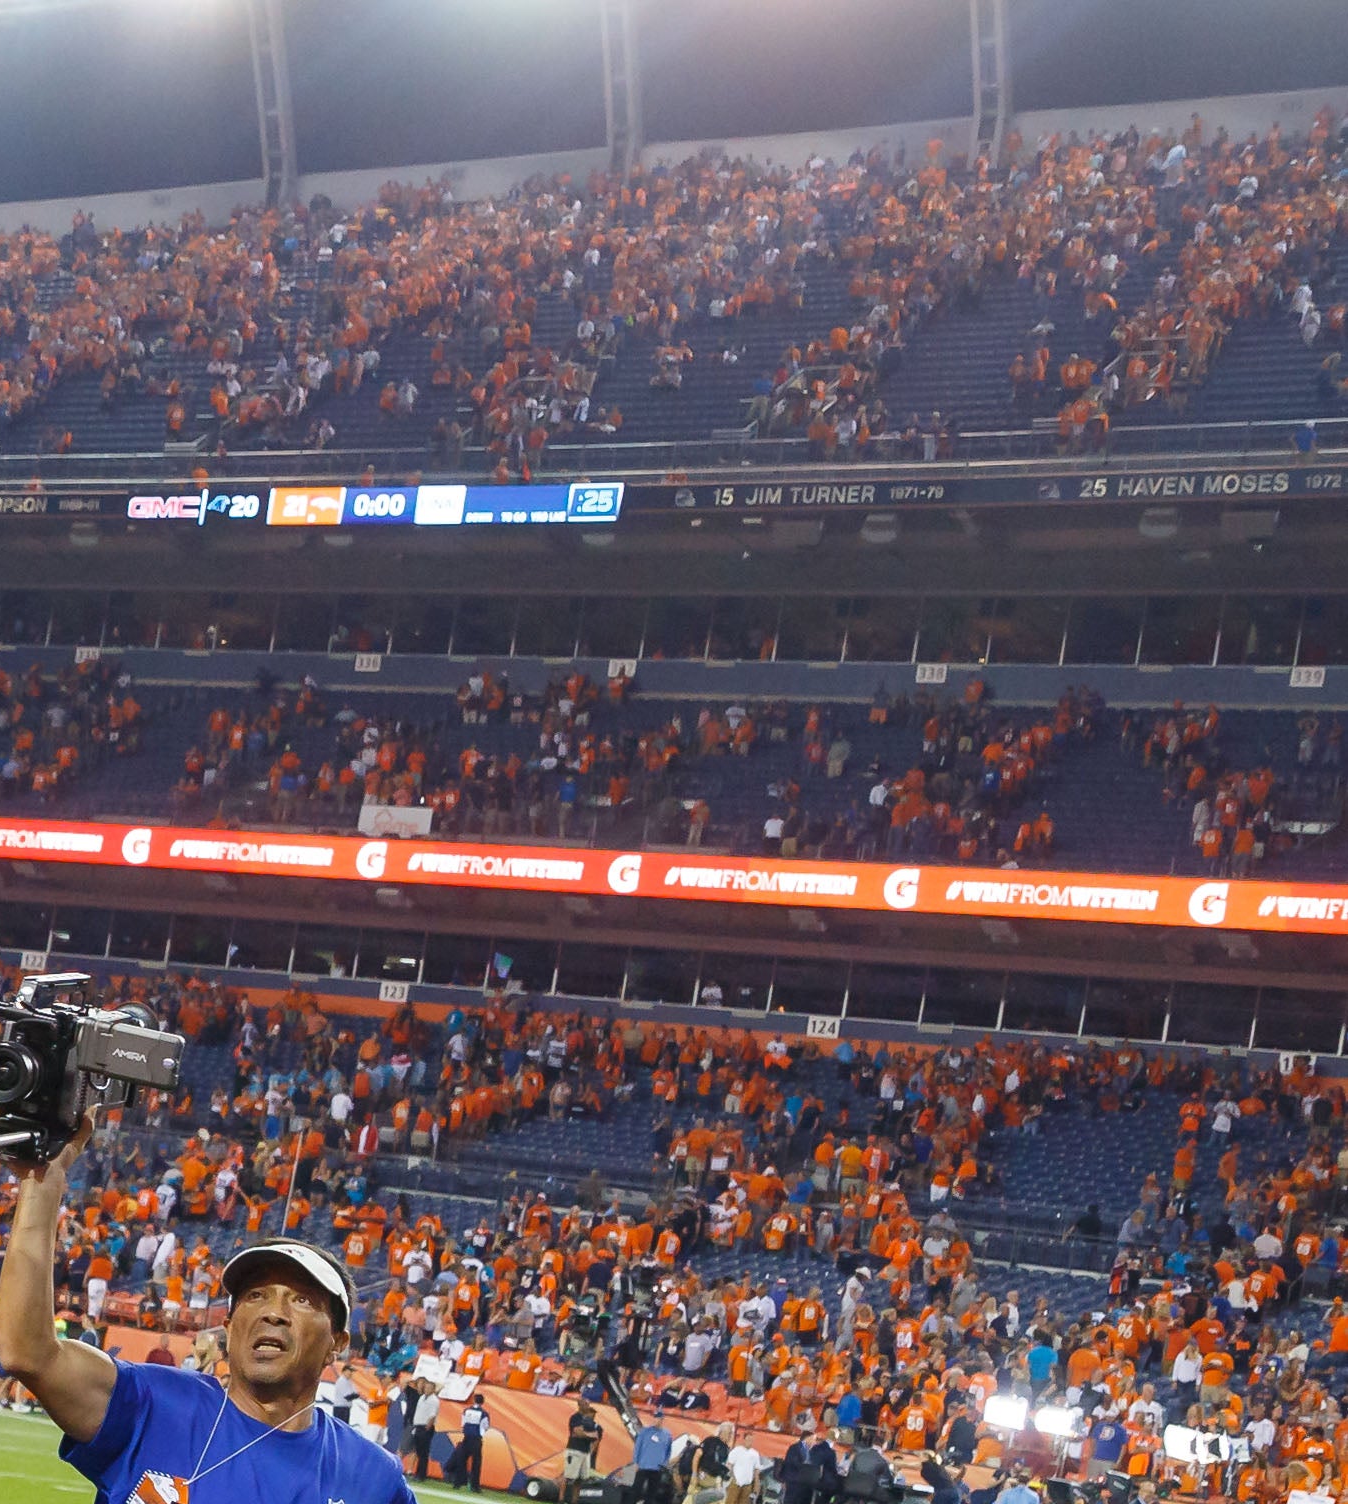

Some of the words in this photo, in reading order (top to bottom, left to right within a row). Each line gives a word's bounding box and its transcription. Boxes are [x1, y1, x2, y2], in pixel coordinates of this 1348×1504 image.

[713, 487, 734, 506] 15
[745, 487, 782, 505] JIM
[790, 485, 876, 505] TURNER
[1079, 477, 1107, 498] 25
[1117, 475, 1195, 498] HAVEN
[1202, 472, 1290, 496] MOSES
[127, 496, 201, 519] GMC
[228, 494, 260, 518] 20
[282, 495, 306, 517] 21
[354, 493, 406, 517] 0:00
[577, 488, 615, 514] :25
[120, 828, 152, 864] G
[355, 841, 388, 878] G
[408, 852, 585, 881] #WINFROMWITHIN
[607, 854, 643, 894] G
[664, 866, 858, 897] #WINFROMWITHIN
[883, 867, 921, 909] G
[946, 880, 1160, 911] #WINFROMWITHIN
[1188, 883, 1229, 925] G
[25, 953, 44, 967] 122
[384, 986, 405, 998] 123
[811, 1020, 837, 1035] 124
[111, 1048, 147, 1063] AMIRA
